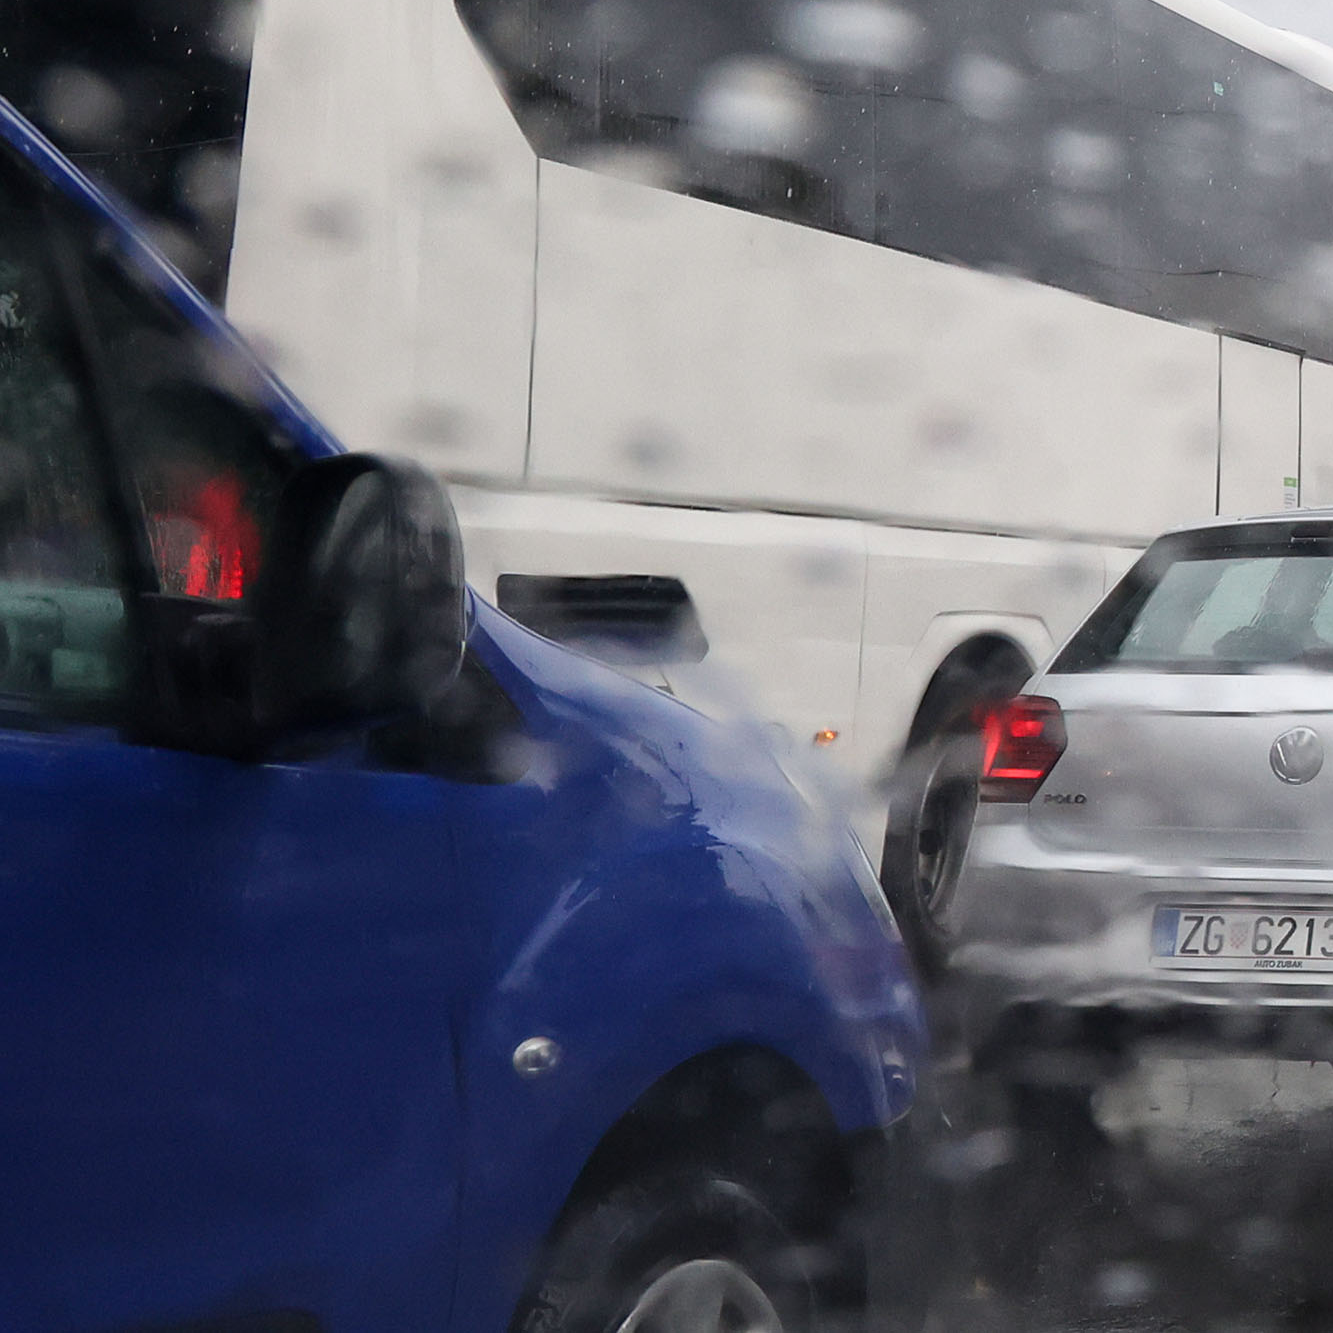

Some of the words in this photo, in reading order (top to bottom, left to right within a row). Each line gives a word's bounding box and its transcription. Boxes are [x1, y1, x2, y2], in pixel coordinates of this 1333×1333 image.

[1044, 793, 1087, 804] POLO
[1180, 915, 1225, 955] ZG
[1254, 960, 1275, 968] AUTO
[1276, 960, 1303, 968] ZUBAK
